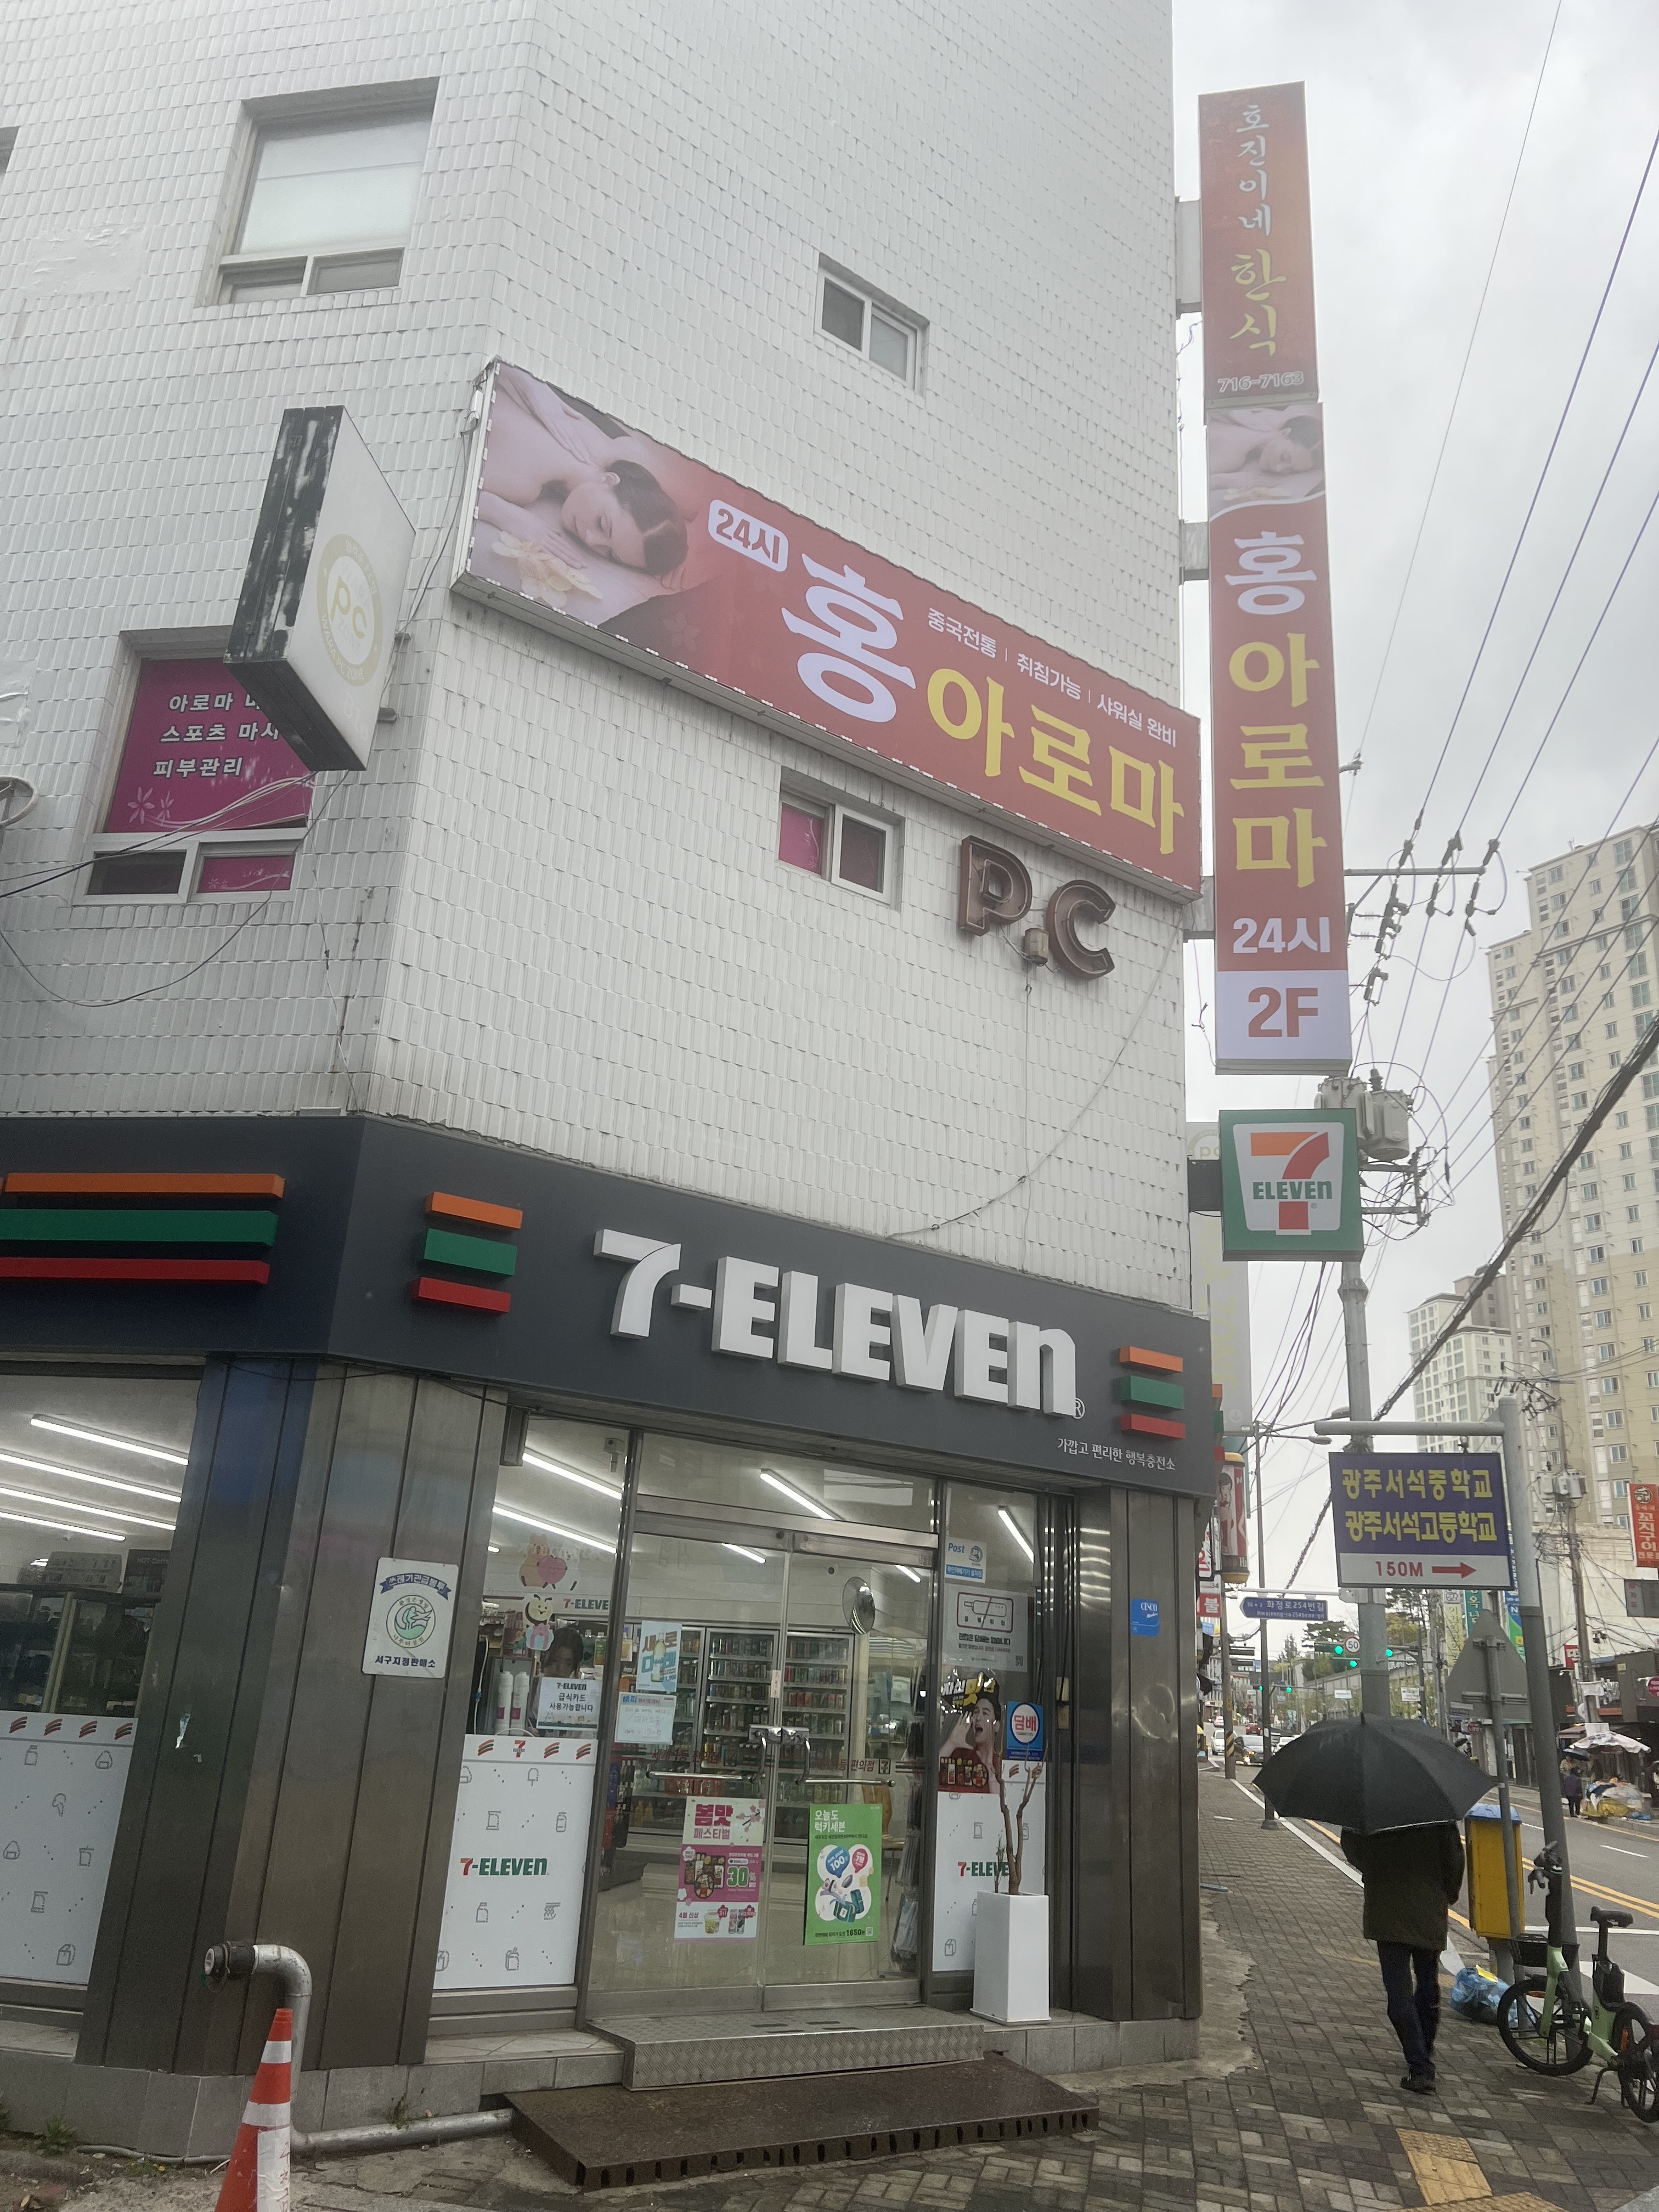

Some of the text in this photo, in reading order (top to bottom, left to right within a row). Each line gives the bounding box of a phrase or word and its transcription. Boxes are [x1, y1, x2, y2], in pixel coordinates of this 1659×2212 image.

[1235, 103, 1272, 237] 호진이네
[1230, 247, 1287, 356] 한식
[1217, 371, 1304, 393] 716-7163
[715, 508, 781, 564] 24시
[346, 668, 365, 680] ZONE
[927, 608, 1177, 747] 중국전통 취침가능 샤워실 완비
[169, 692, 234, 712] 아로마
[160, 724, 226, 742] 스포츠
[154, 757, 243, 778] 피부관리
[961, 835, 1116, 980] PC
[1232, 917, 1330, 955] 24시
[1248, 986, 1319, 1039] 2F
[1057, 1438, 1176, 1471] 가깝고 편리한 행복충전소
[1345, 1511, 1498, 1543] 광주서석고등학교
[948, 1543, 965, 1553] Post
[1375, 1561, 1424, 1577] 150M
[1267, 1600, 1324, 1612] 화정로254번길
[375, 1655, 436, 1668] 서구지정판매소
[549, 1702, 593, 1711] 사용가능합니다
[558, 1693, 586, 1702] 급식카드
[1014, 1715, 1036, 1732] 담배
[850, 1759, 875, 1772] 편의점
[695, 1804, 733, 1827] 봄맛
[814, 1810, 839, 1821] 오늘도
[693, 1827, 730, 1839] 페스티벌
[815, 1821, 845, 1832] 럭키세븐
[830, 1856, 845, 1871] 100
